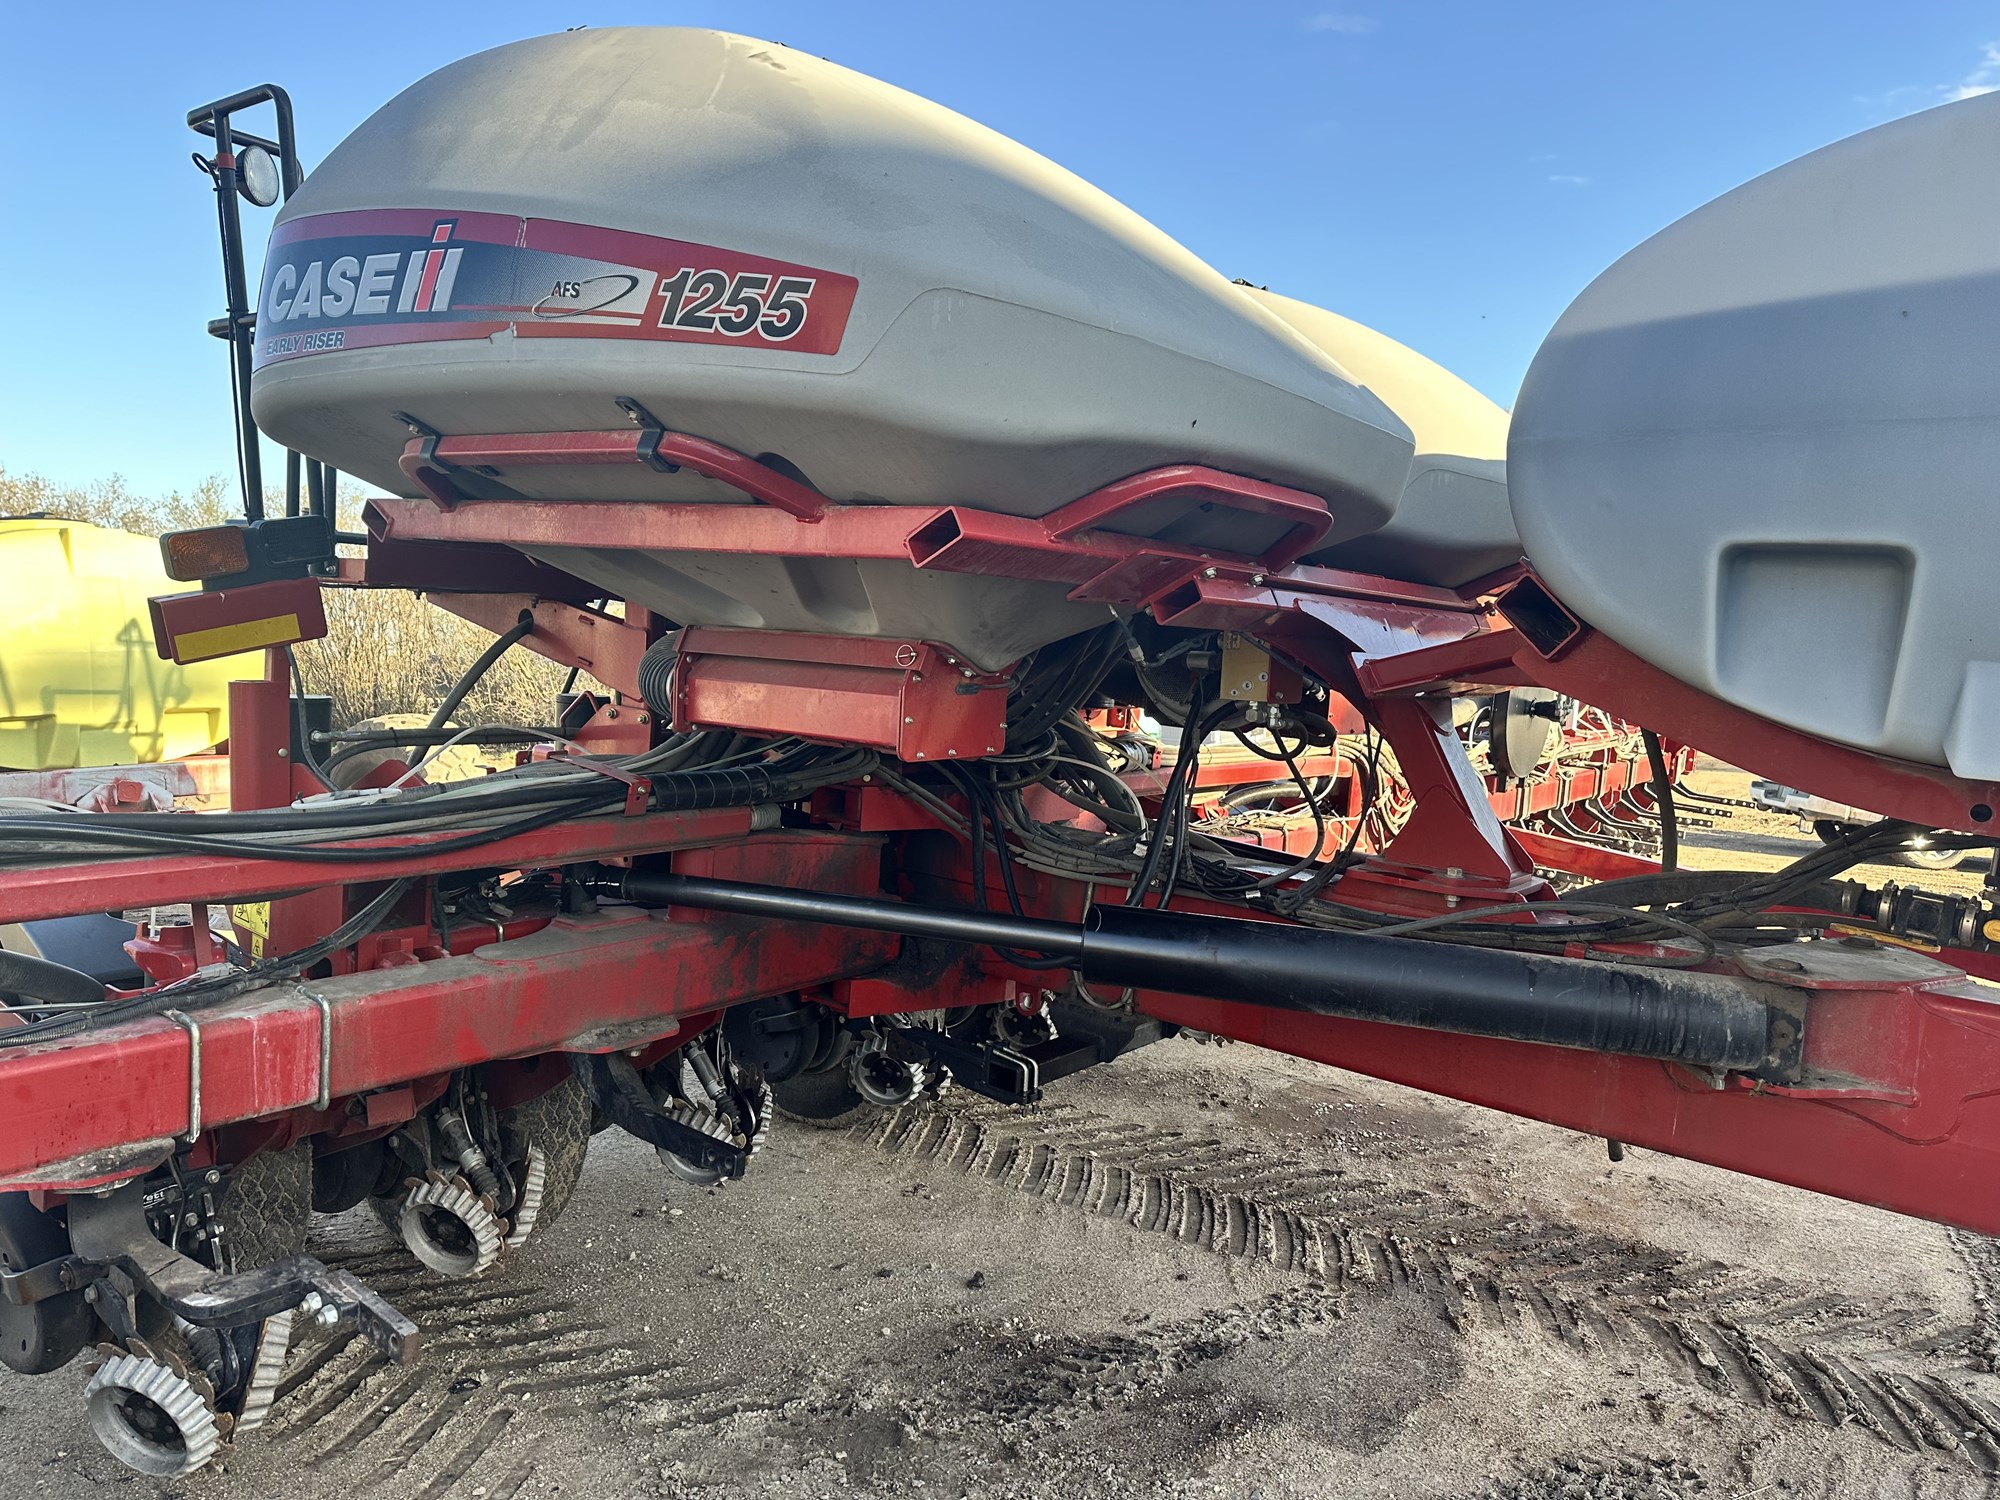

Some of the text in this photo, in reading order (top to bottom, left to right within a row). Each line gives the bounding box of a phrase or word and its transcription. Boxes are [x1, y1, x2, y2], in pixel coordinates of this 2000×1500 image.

[268, 253, 401, 323] CASE
[551, 280, 581, 299] AFS
[657, 267, 817, 342] 1255
[265, 330, 345, 357] EARLY RISER
